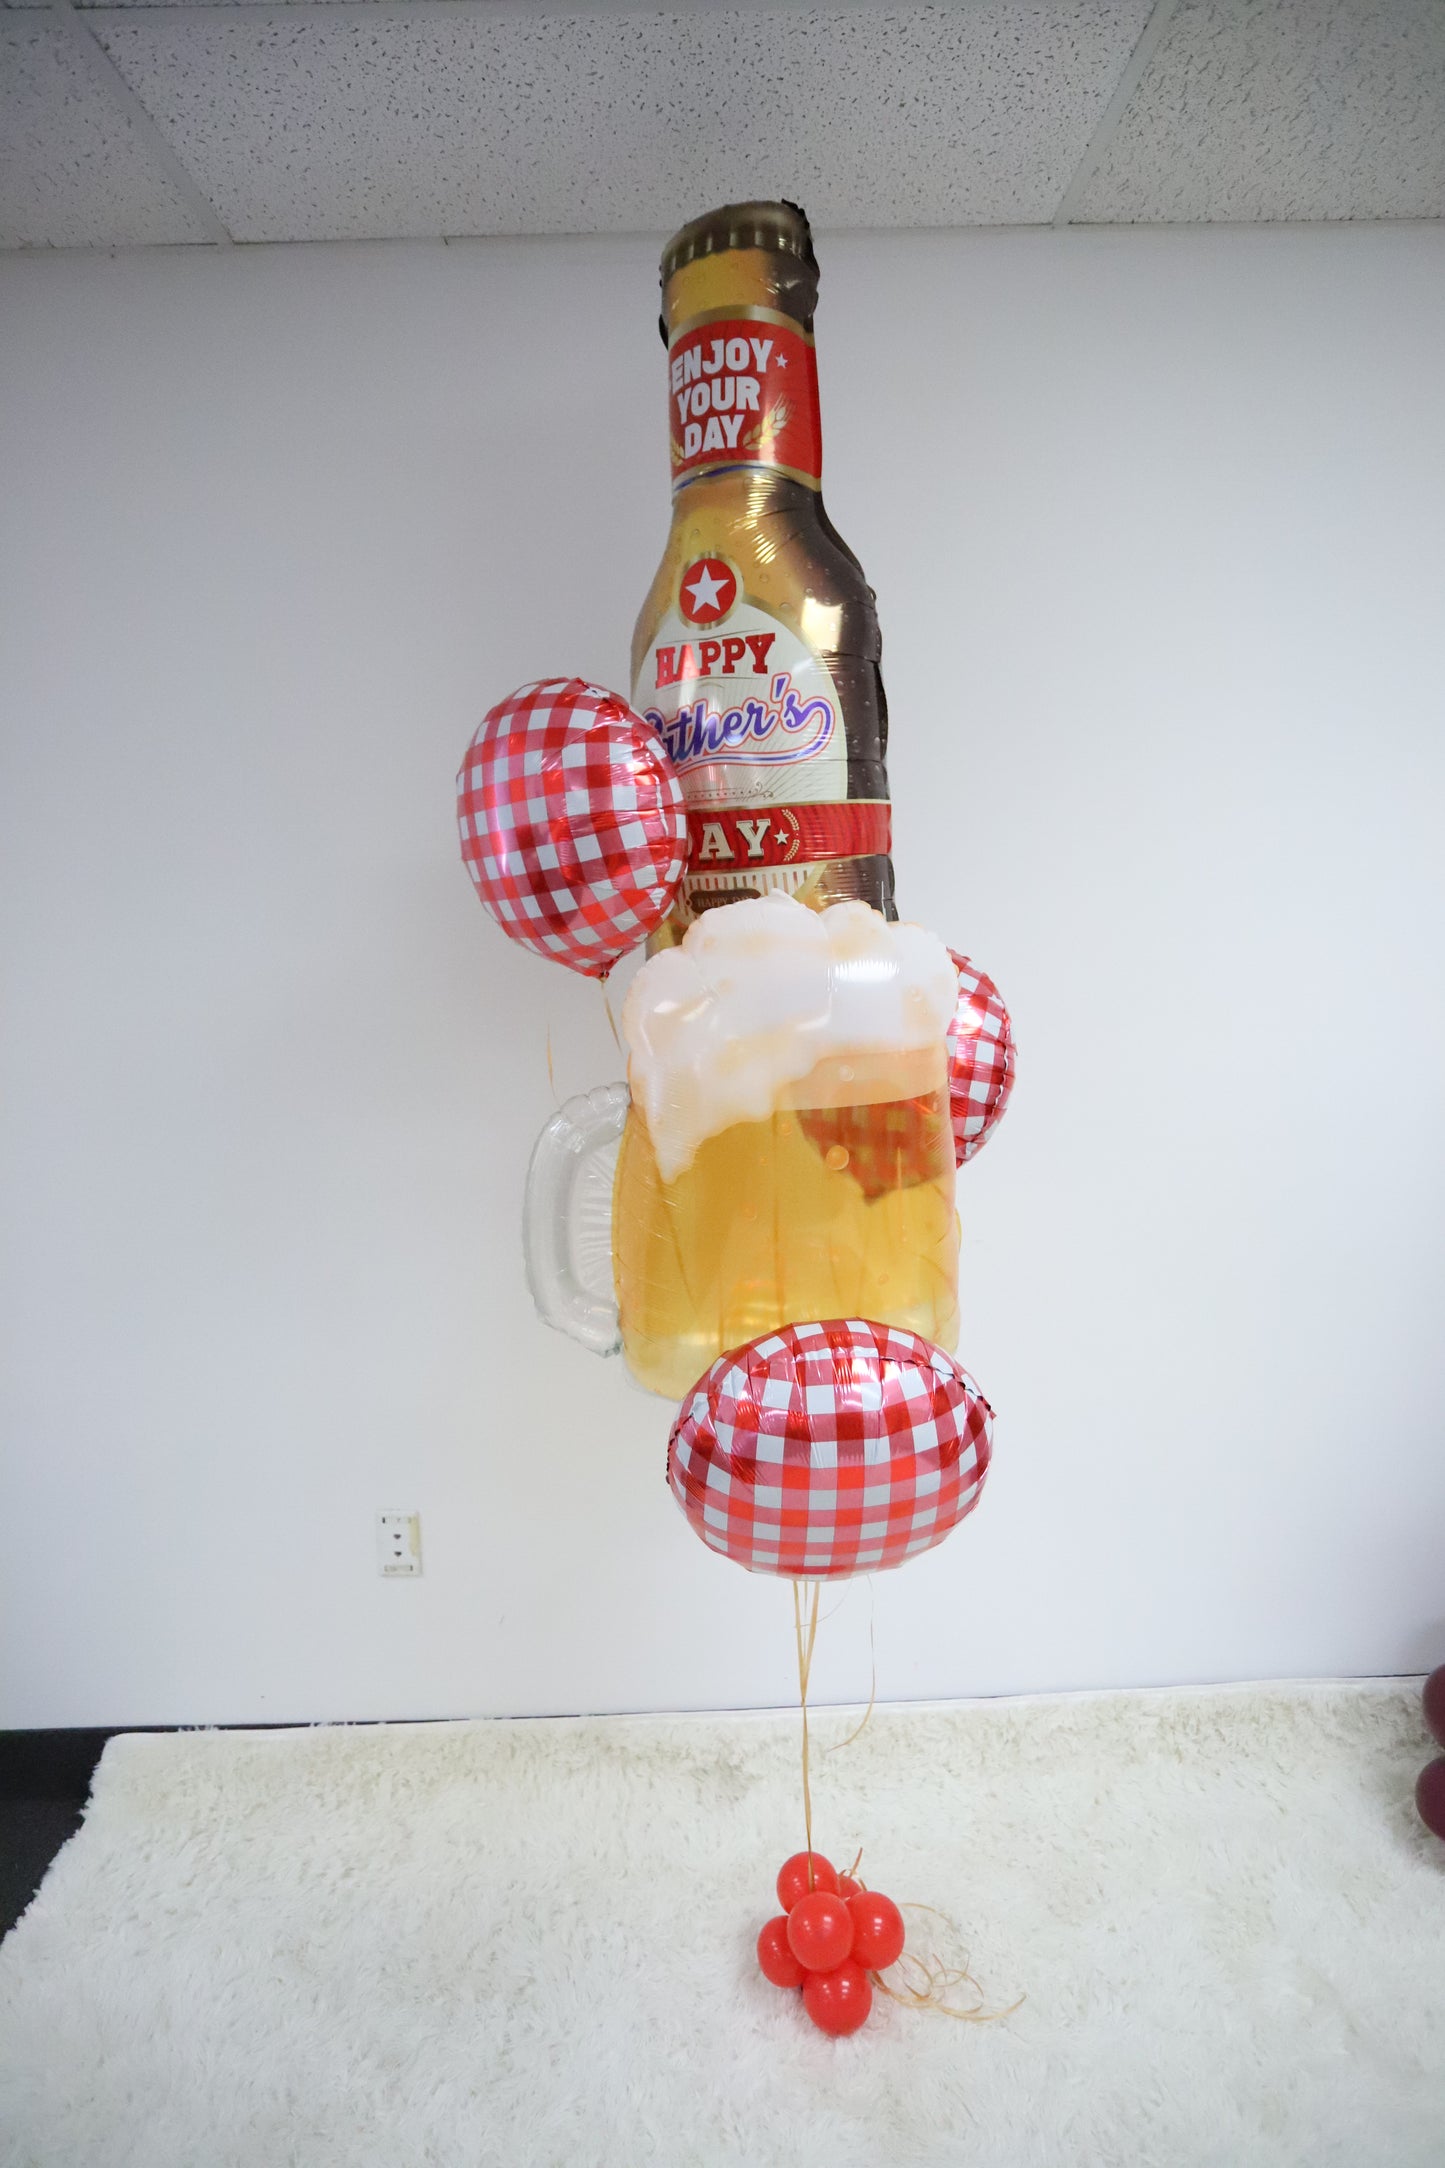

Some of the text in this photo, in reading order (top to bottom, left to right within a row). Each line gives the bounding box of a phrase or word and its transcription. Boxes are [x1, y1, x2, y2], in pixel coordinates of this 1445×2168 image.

[672, 337, 774, 395] ENJOY
[677, 376, 760, 425] YOUR
[684, 414, 745, 457] DAY
[655, 632, 776, 689] HAPPY
[643, 673, 834, 768] ther's
[687, 818, 771, 862] AY
